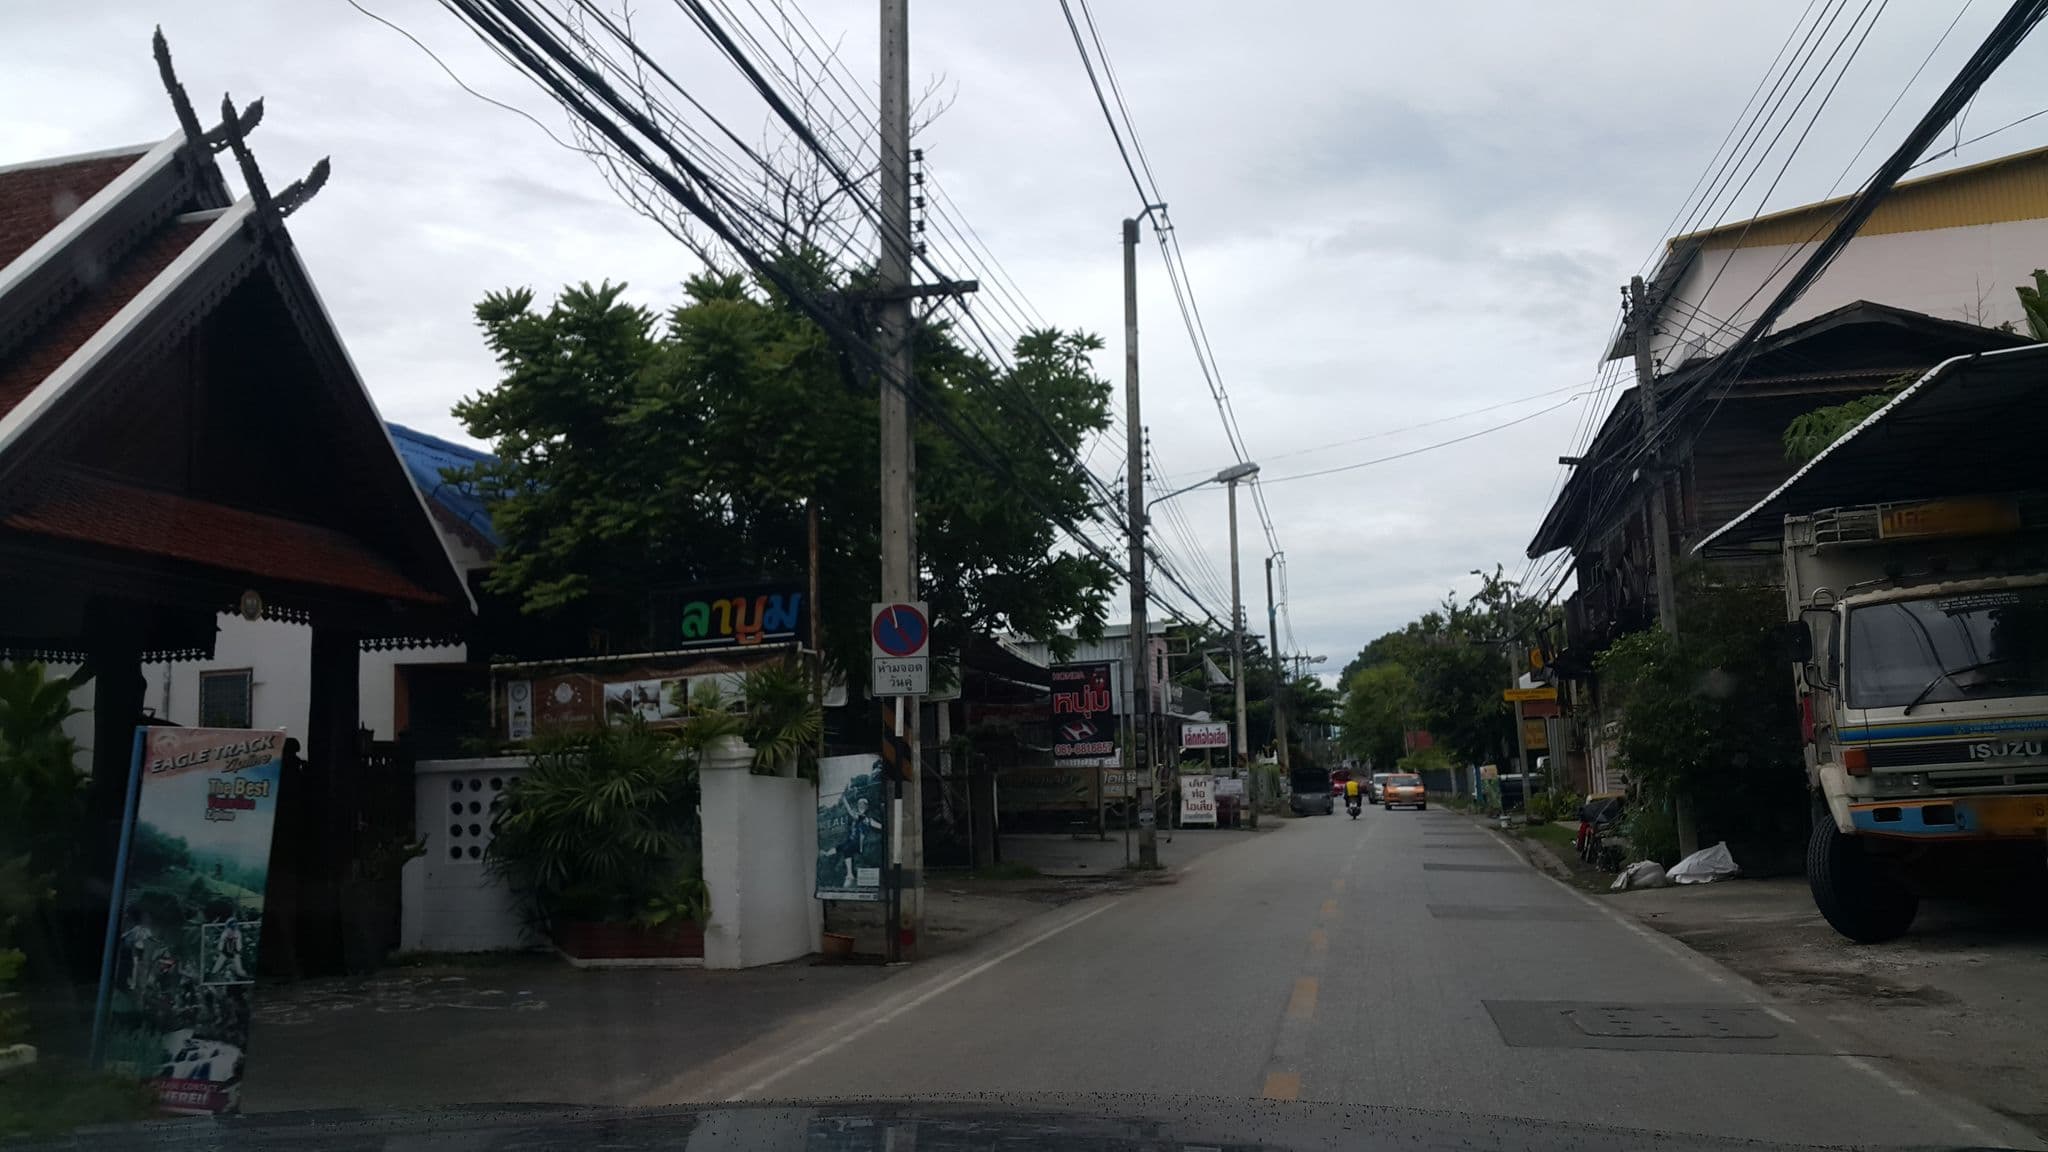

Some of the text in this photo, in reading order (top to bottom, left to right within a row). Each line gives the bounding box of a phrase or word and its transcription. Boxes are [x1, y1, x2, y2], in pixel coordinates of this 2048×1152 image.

[681, 592, 802, 645] ลาบูม
[878, 660, 923, 673] ห้ามจอด
[889, 675, 913, 692] วันคู่
[1053, 684, 1111, 719] หนุ่ม
[152, 735, 276, 774] EAGLE TRACK
[1968, 740, 2043, 760] ISUZU
[208, 777, 270, 797] The Best
